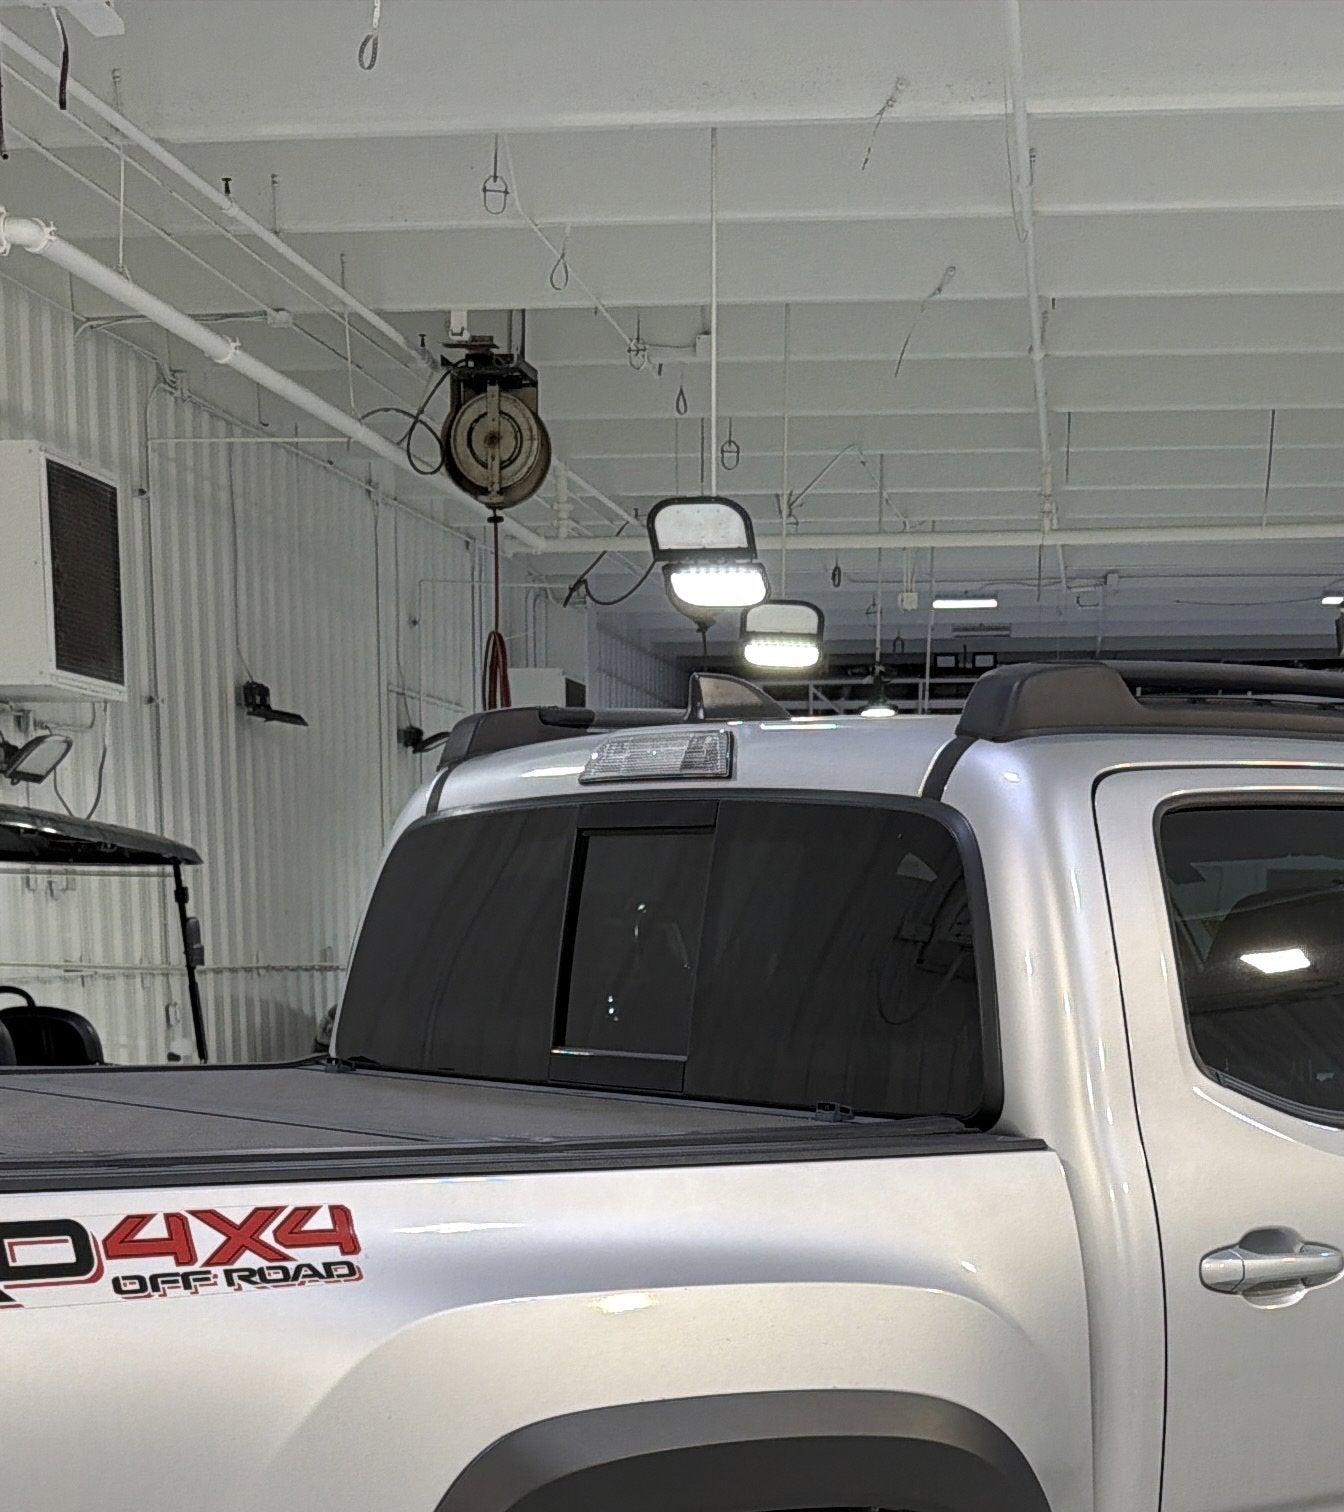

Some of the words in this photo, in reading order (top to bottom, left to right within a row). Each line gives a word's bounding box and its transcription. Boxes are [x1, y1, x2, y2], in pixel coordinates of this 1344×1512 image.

[102, 1204, 362, 1268] 4X4
[111, 1270, 214, 1299] OFF
[224, 1259, 363, 1289] ROAD
